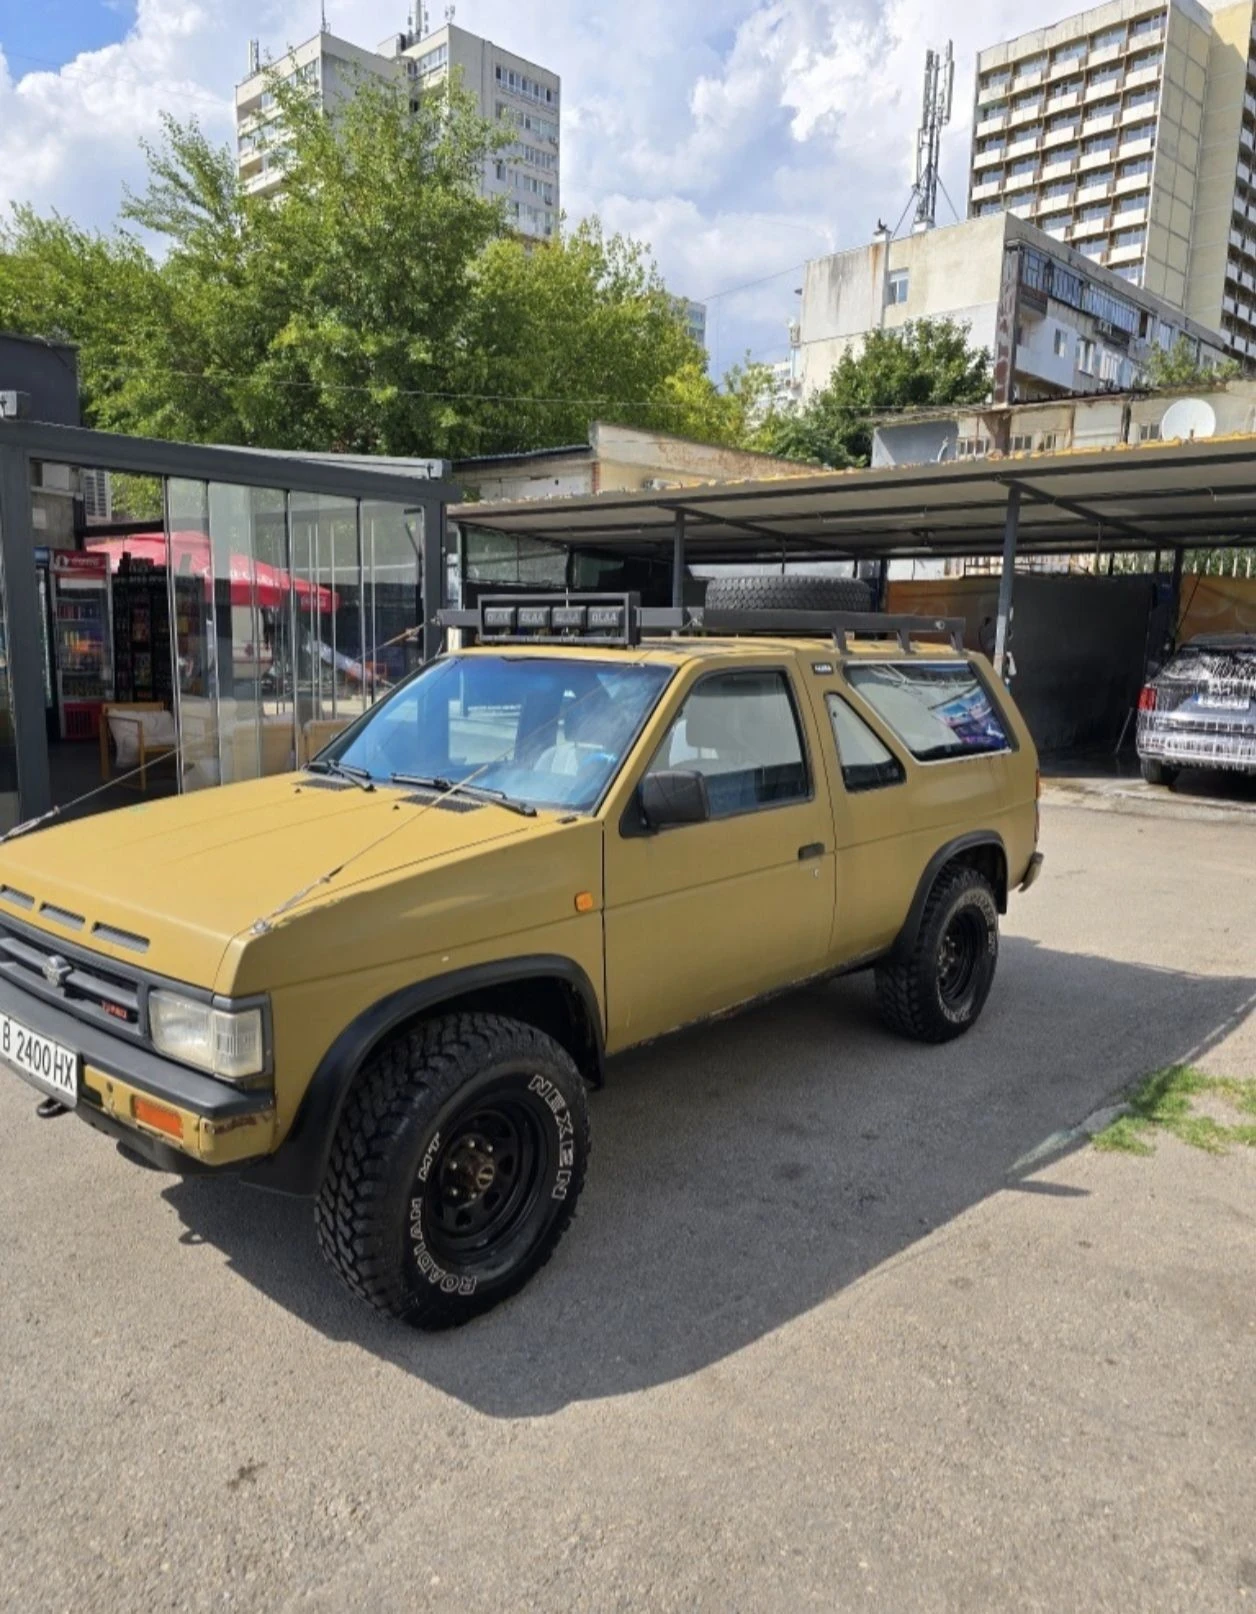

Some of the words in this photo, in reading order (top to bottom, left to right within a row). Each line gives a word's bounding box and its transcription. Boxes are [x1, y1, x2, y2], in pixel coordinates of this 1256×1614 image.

[3, 1021, 11, 1052] B
[528, 1074, 574, 1200] NEXEN
[410, 1198, 477, 1295] ROADIAN
